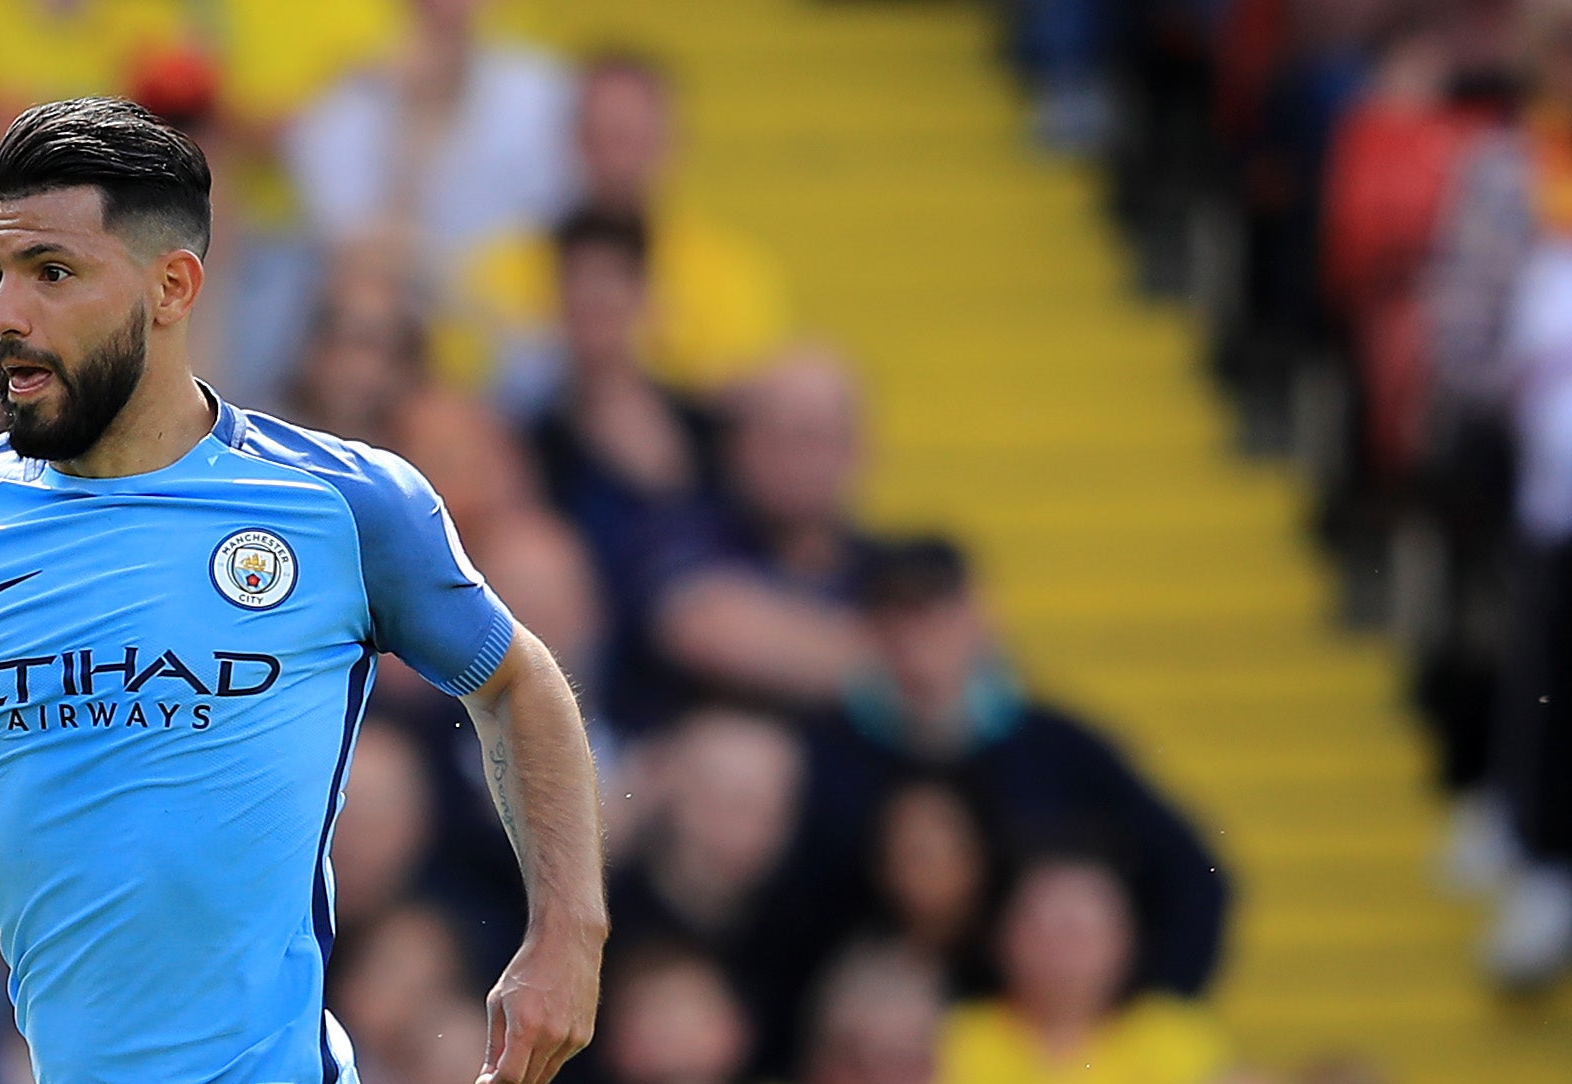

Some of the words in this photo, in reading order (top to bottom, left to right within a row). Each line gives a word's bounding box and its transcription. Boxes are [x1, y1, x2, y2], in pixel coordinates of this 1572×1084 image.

[222, 534, 289, 563] MANCHESTER
[238, 594, 264, 604] CITY
[7, 702, 212, 731] AIRWAYS
